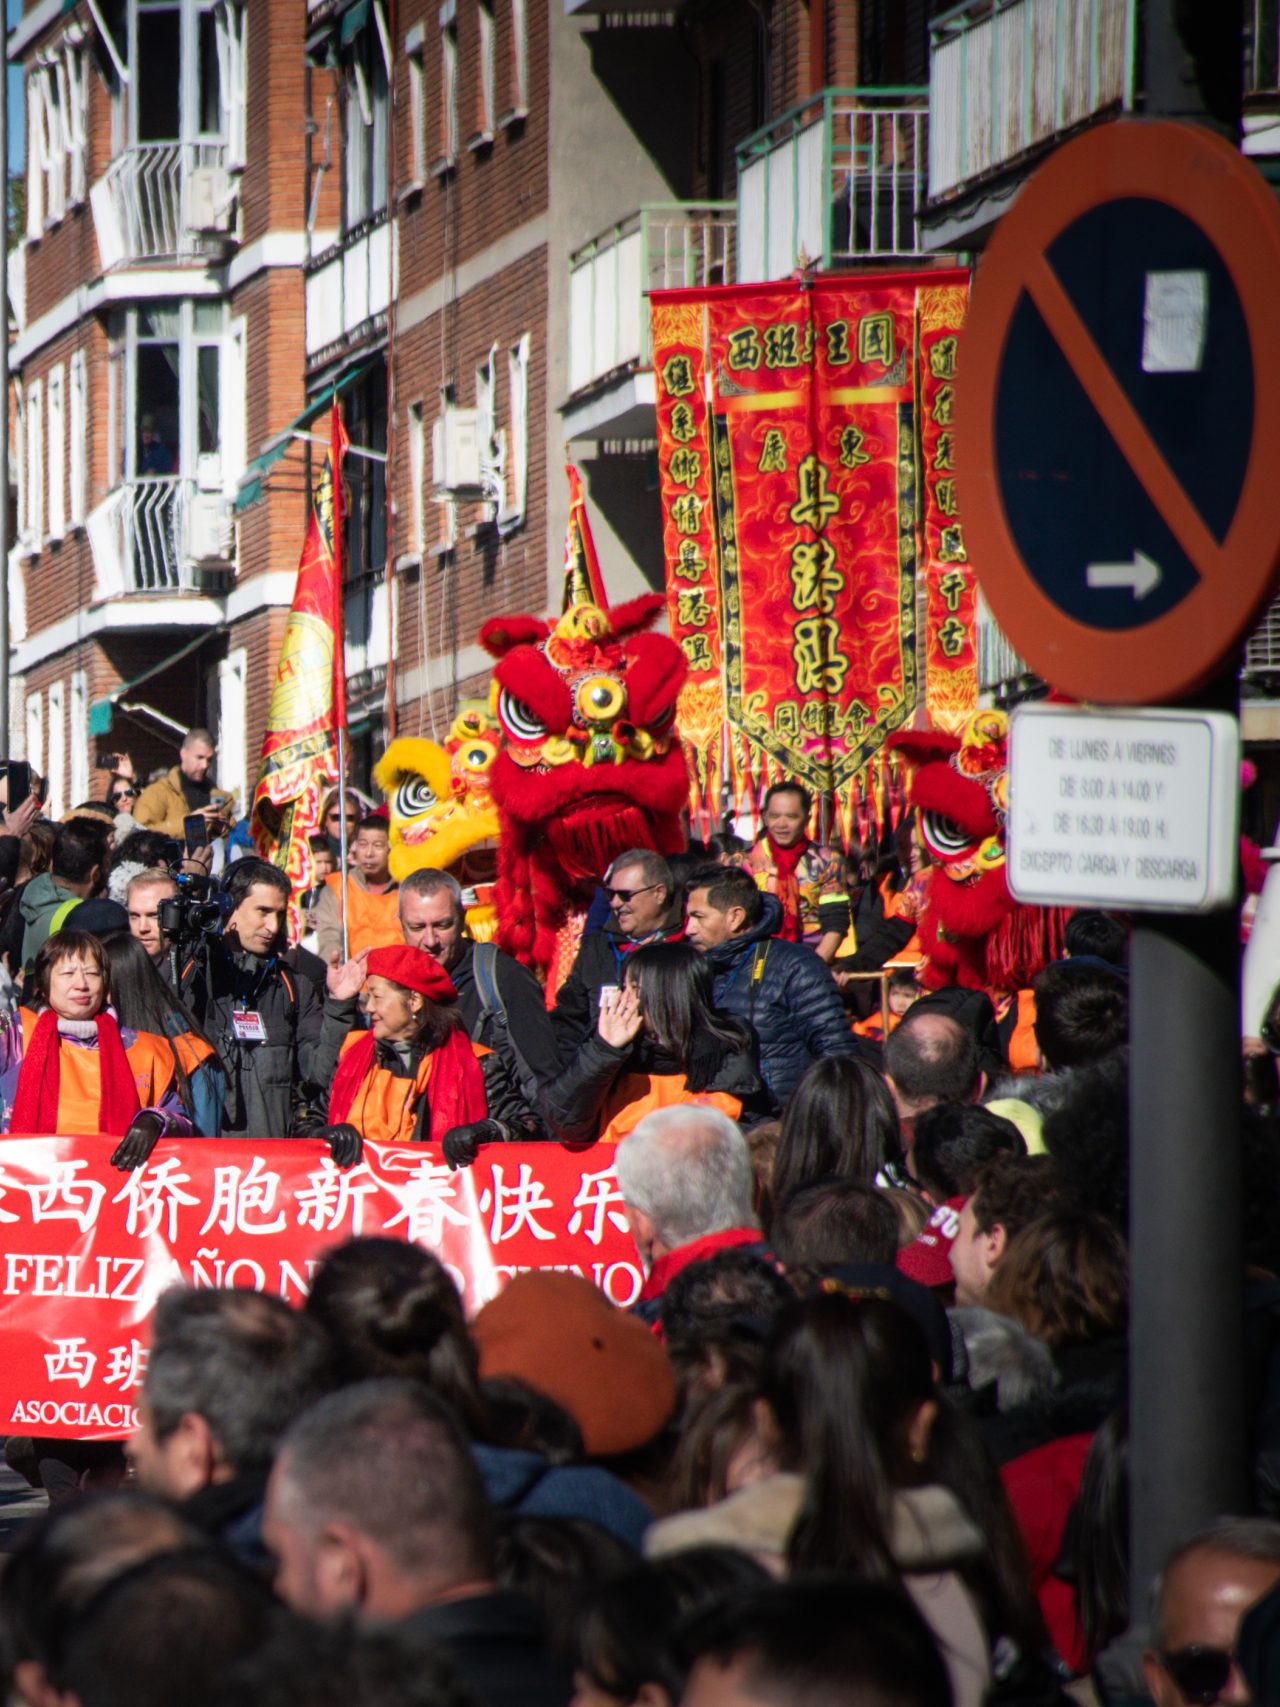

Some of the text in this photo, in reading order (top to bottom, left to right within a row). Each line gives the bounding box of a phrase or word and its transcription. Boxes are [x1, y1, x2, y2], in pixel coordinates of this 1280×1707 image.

[1049, 736, 1177, 766] DE LUNES A VIERNES
[1059, 775, 1076, 798] DE
[1107, 777, 1117, 800] A
[1154, 780, 1165, 801] Y
[1053, 812, 1071, 834] DE
[1108, 814, 1117, 836] A
[1020, 848, 1199, 881] EXCEPTO CARGA Y DESCARGA
[3, 1253, 145, 1301] FELIZ
